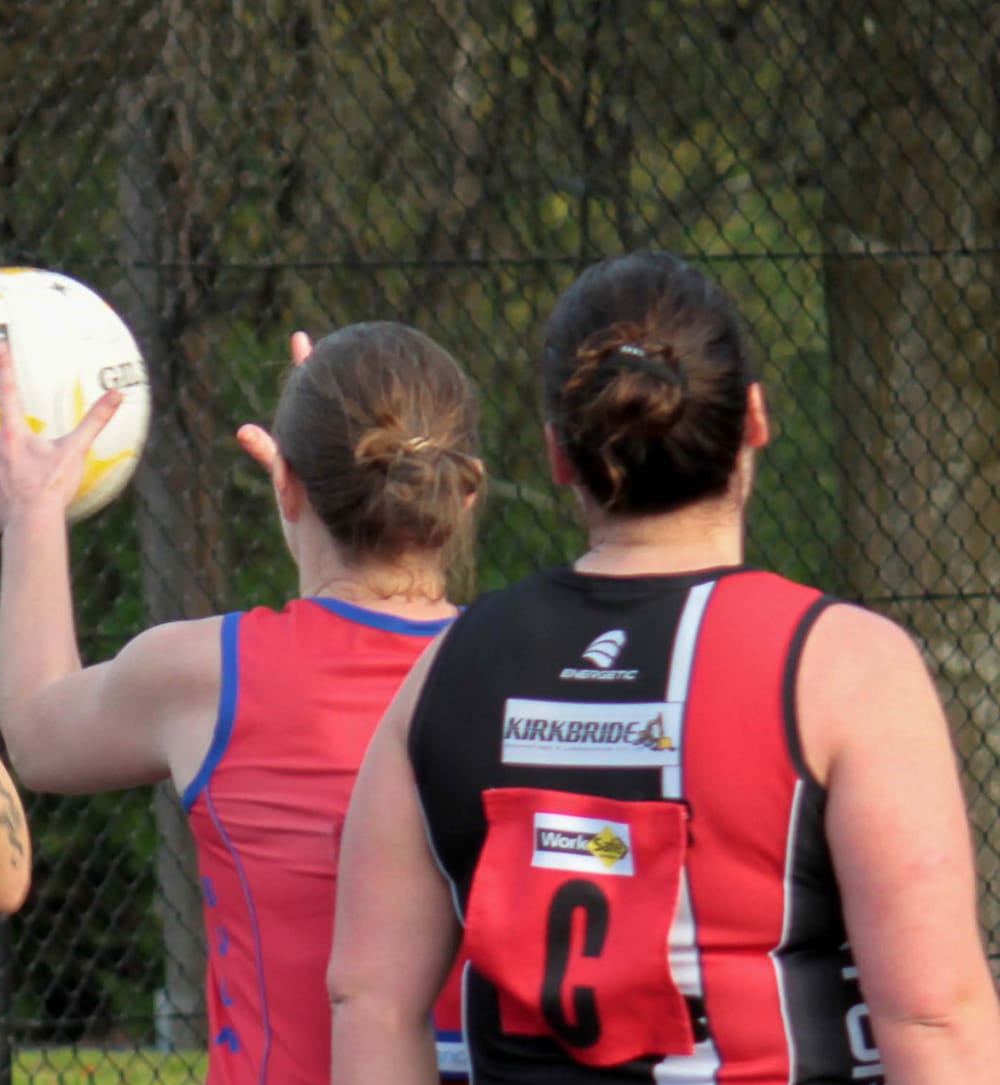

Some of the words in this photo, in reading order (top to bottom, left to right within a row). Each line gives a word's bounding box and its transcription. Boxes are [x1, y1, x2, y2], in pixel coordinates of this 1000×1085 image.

[559, 668, 639, 680] ENERGETIC
[504, 717, 640, 744] KIRKBRIDE
[541, 879, 611, 1049] C
